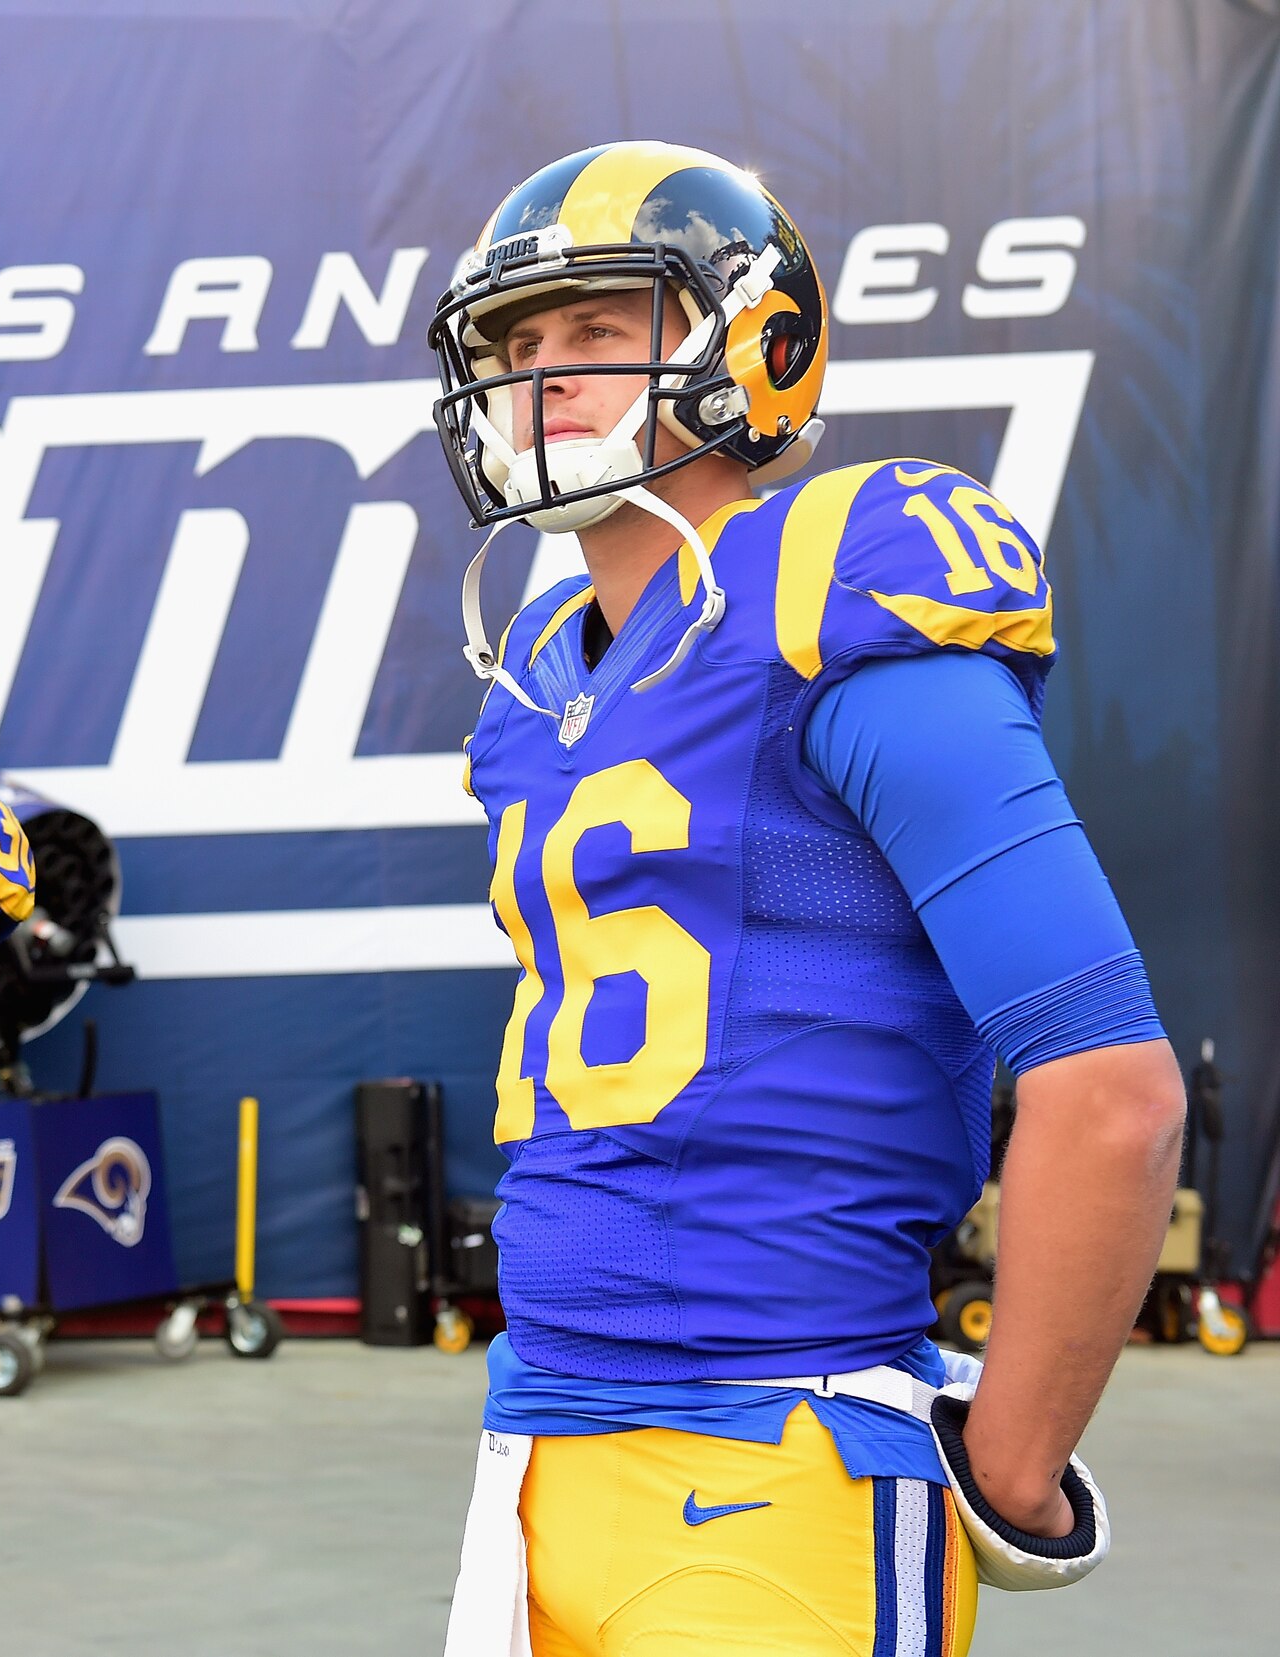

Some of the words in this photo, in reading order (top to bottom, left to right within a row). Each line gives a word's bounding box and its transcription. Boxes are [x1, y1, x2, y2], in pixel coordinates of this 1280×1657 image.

[144, 216, 1087, 356] ANES
[485, 236, 539, 267] RAMS
[902, 486, 1039, 596] 16
[492, 758, 712, 1145] 16
